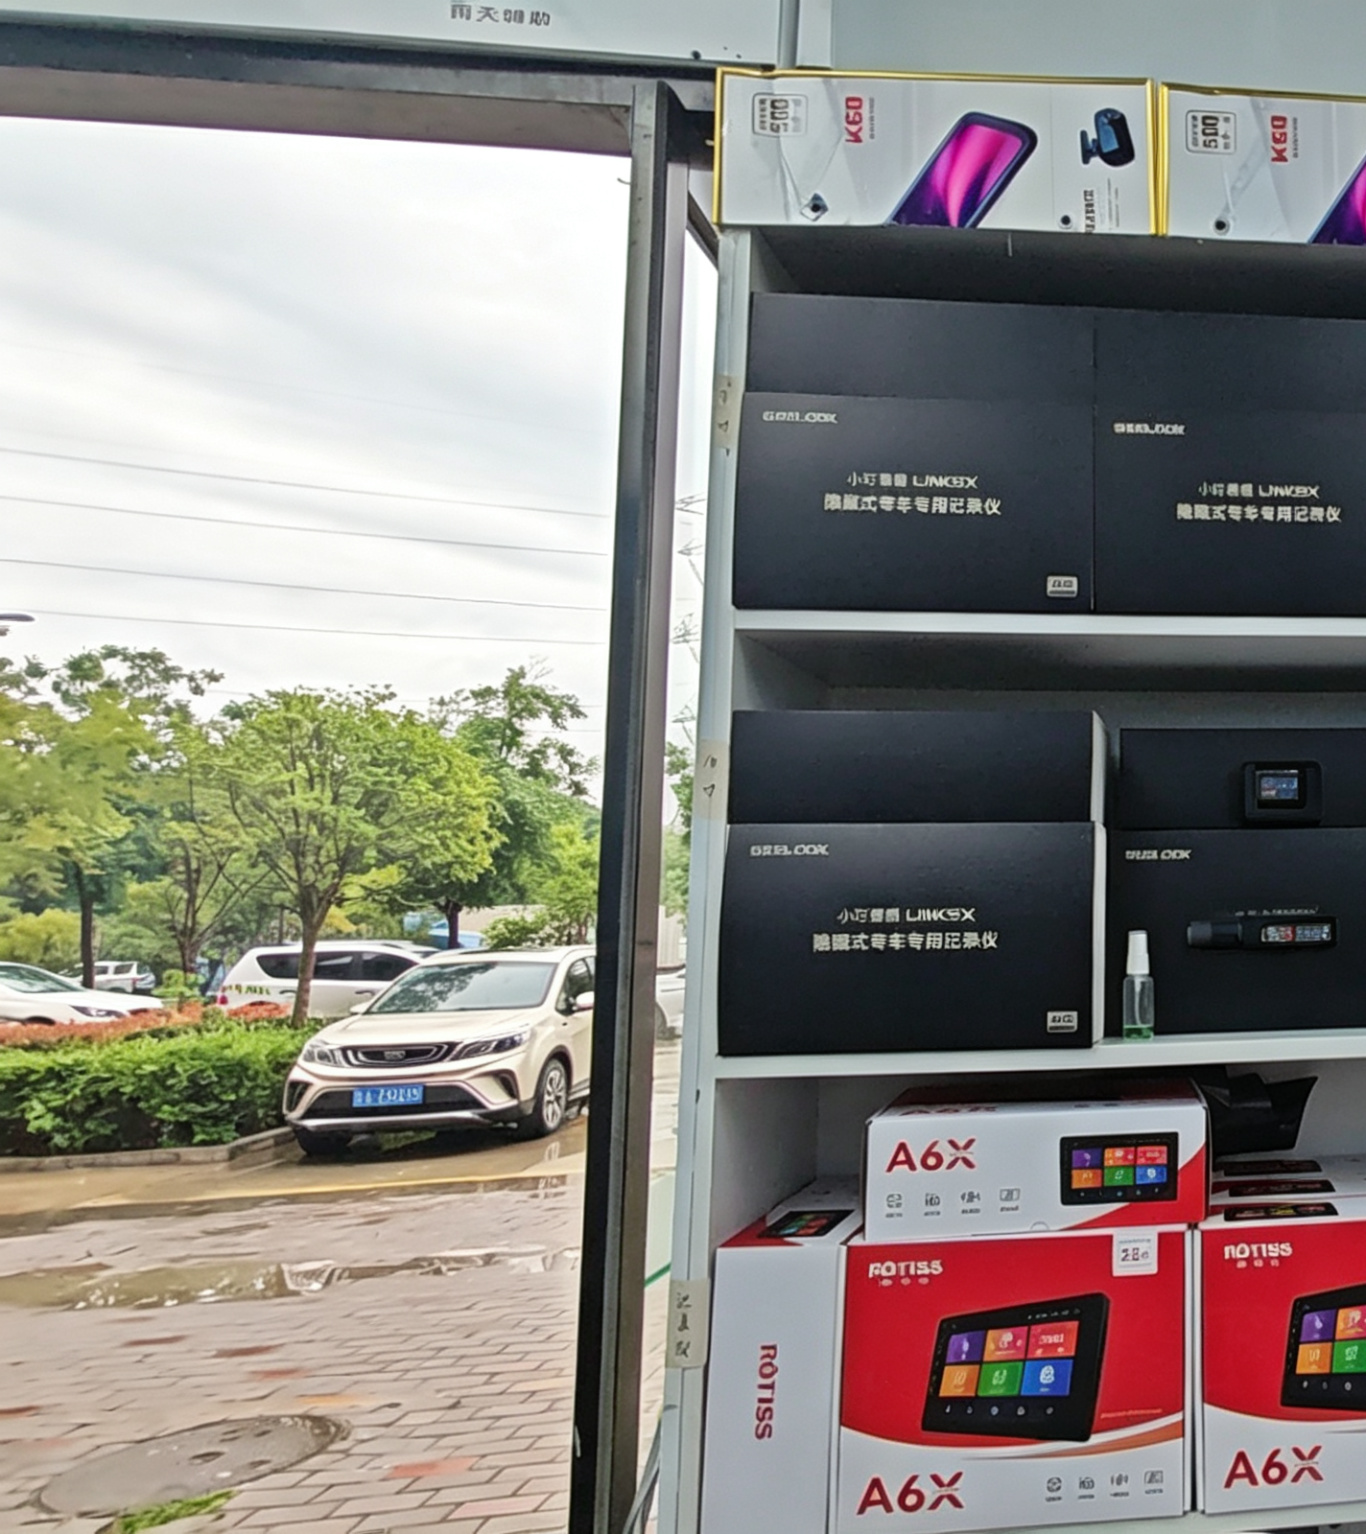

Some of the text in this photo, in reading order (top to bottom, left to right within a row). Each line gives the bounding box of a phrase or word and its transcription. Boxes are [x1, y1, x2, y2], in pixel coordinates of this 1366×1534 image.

[844, 96, 864, 144] K60
[885, 1138, 976, 1173] A6X
[1223, 1444, 1324, 1490] A6X
[856, 1471, 965, 1515] A6X
